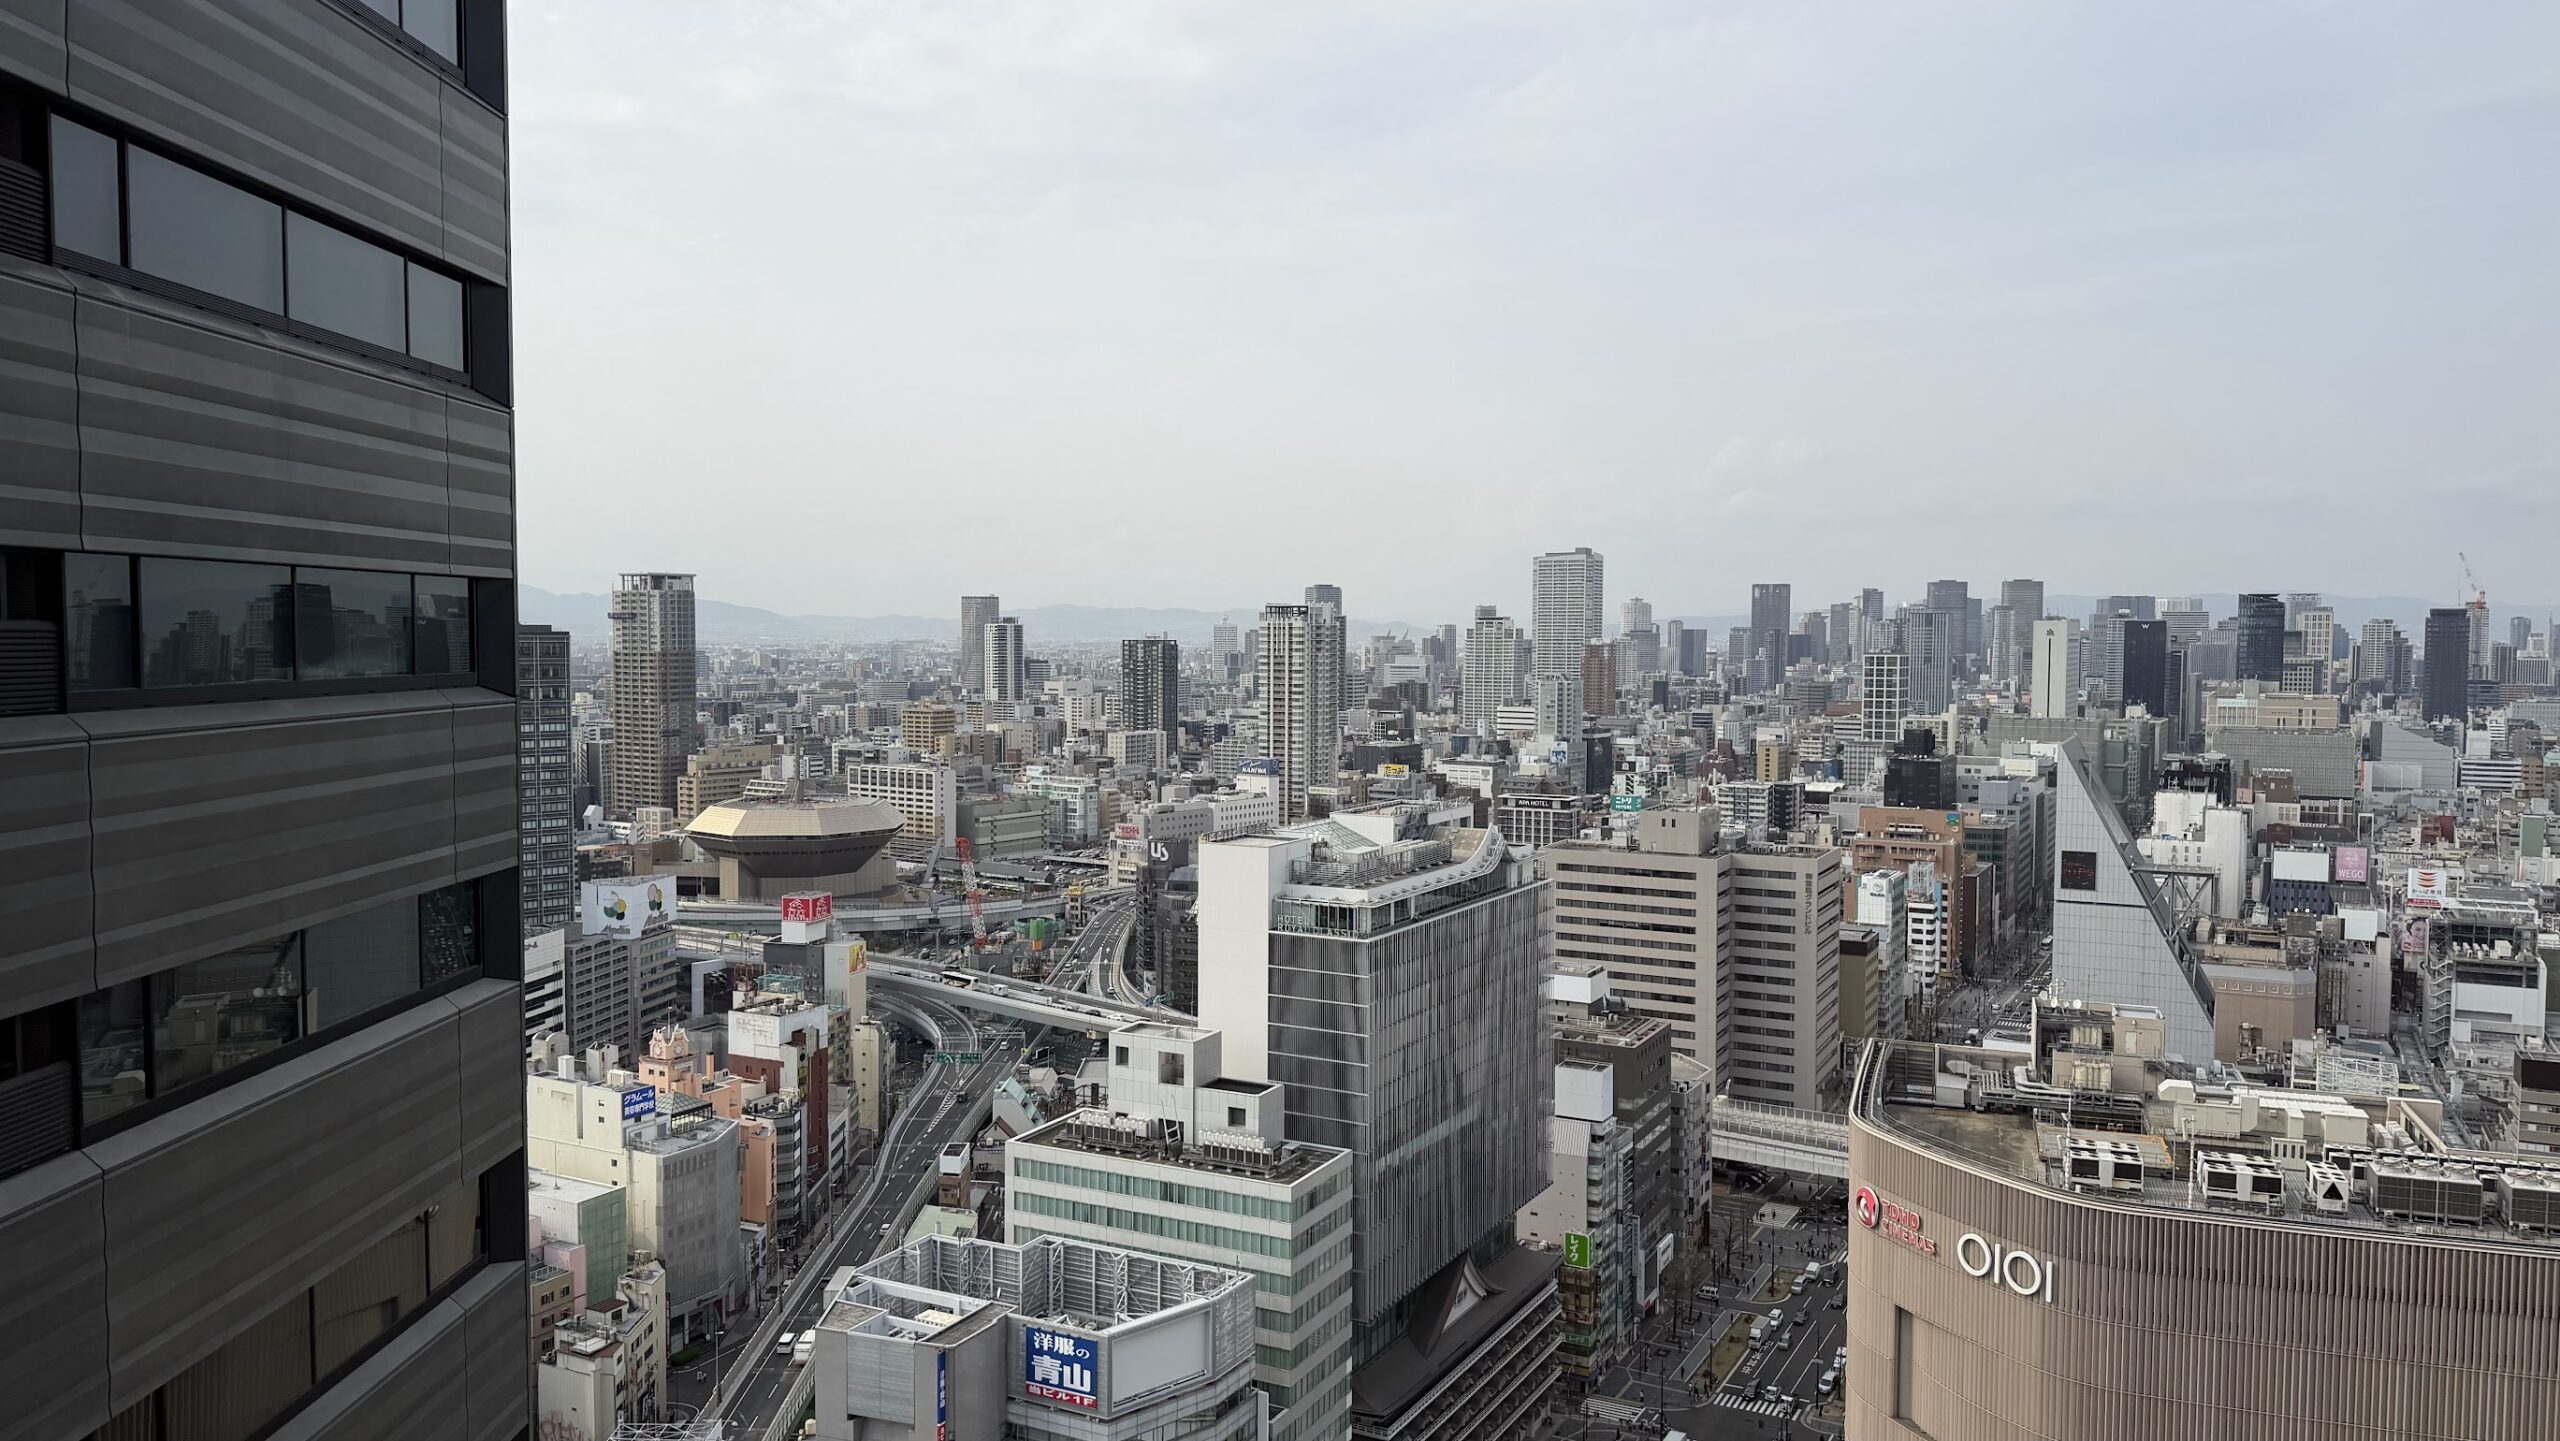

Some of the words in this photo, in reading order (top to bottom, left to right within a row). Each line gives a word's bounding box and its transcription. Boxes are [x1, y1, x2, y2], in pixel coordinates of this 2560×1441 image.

[2338, 869, 2364, 879] WEGO
[1277, 914, 1310, 926] HOTEL
[1277, 923, 1307, 934] ROYAL
[624, 1089, 654, 1105] グラムール
[1881, 1199, 1921, 1231] TOHO
[1569, 1234, 1579, 1262] レイク
[1880, 1218, 1936, 1255] CINEMAS
[1033, 1331, 1090, 1360] 洋服の
[1031, 1354, 1091, 1393] 青山
[1028, 1384, 1094, 1406] 当ビル1F
